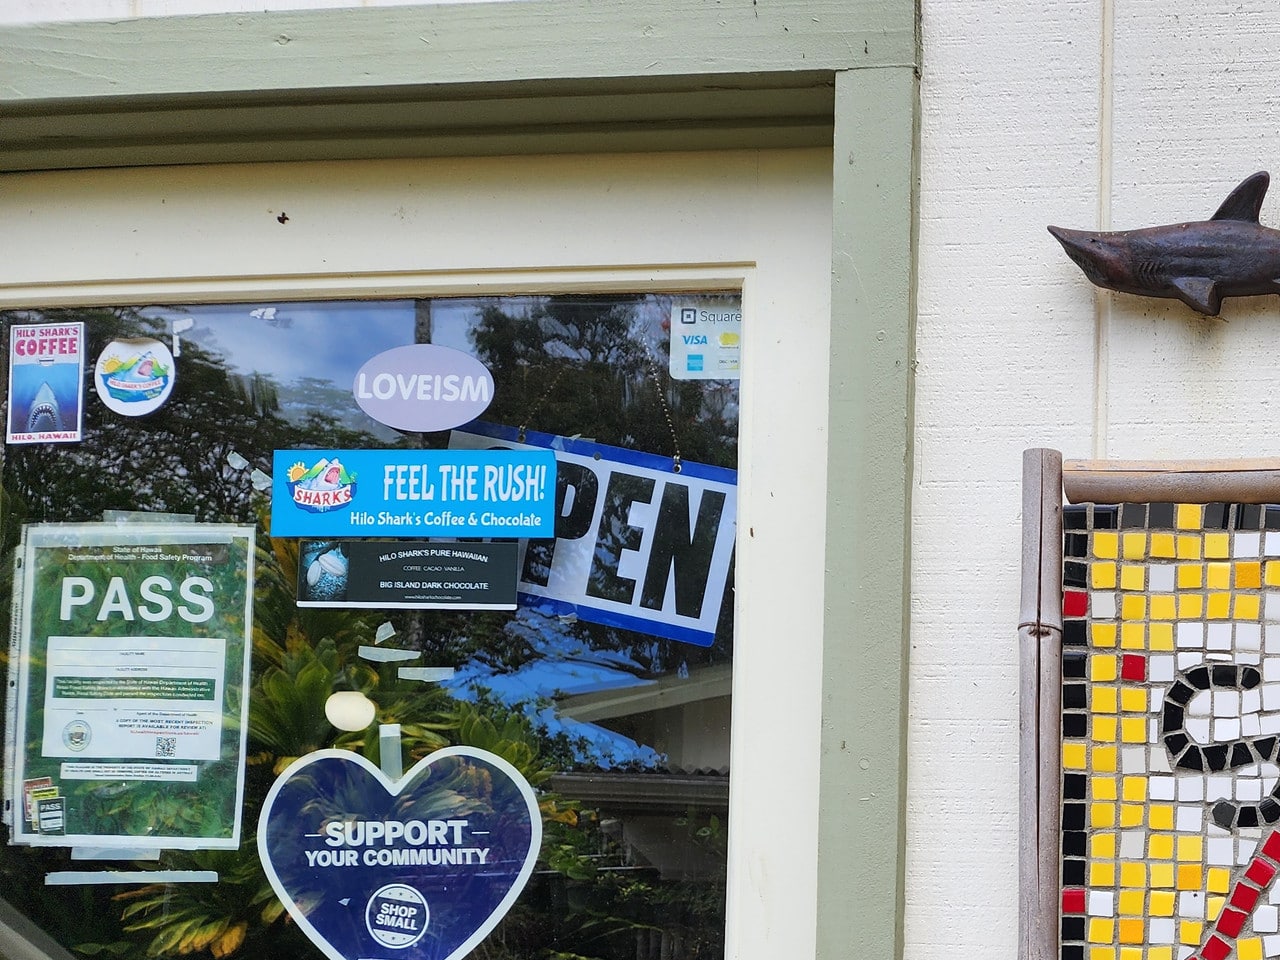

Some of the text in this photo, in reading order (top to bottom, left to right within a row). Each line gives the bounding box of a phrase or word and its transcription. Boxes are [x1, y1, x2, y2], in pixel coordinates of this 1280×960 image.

[700, 310, 742, 325] Square
[16, 327, 79, 338] HILO SHARK'S
[682, 335, 708, 345] VISA
[15, 338, 78, 356] COFFEE
[358, 373, 489, 402] LOVEISM
[38, 432, 77, 440] HAWAII
[383, 464, 547, 502] FEEL THE RUSH!
[350, 512, 541, 526] Hilo Shark's Coffee & Chocolate
[503, 450, 726, 620] PEN
[142, 553, 158, 561] Food
[159, 554, 181, 562] Safety
[182, 554, 212, 562] Program
[379, 549, 489, 563] HILO SHARK'S PURE HAWAIIAN
[379, 581, 489, 590] BIG ISLAND DARK CHOCOLATE
[59, 576, 215, 623] PASS
[325, 820, 468, 847] SUPPORT
[304, 848, 490, 867] YOUR COMMUNITY
[380, 902, 418, 919] SHOP
[375, 913, 418, 931] SMALL
